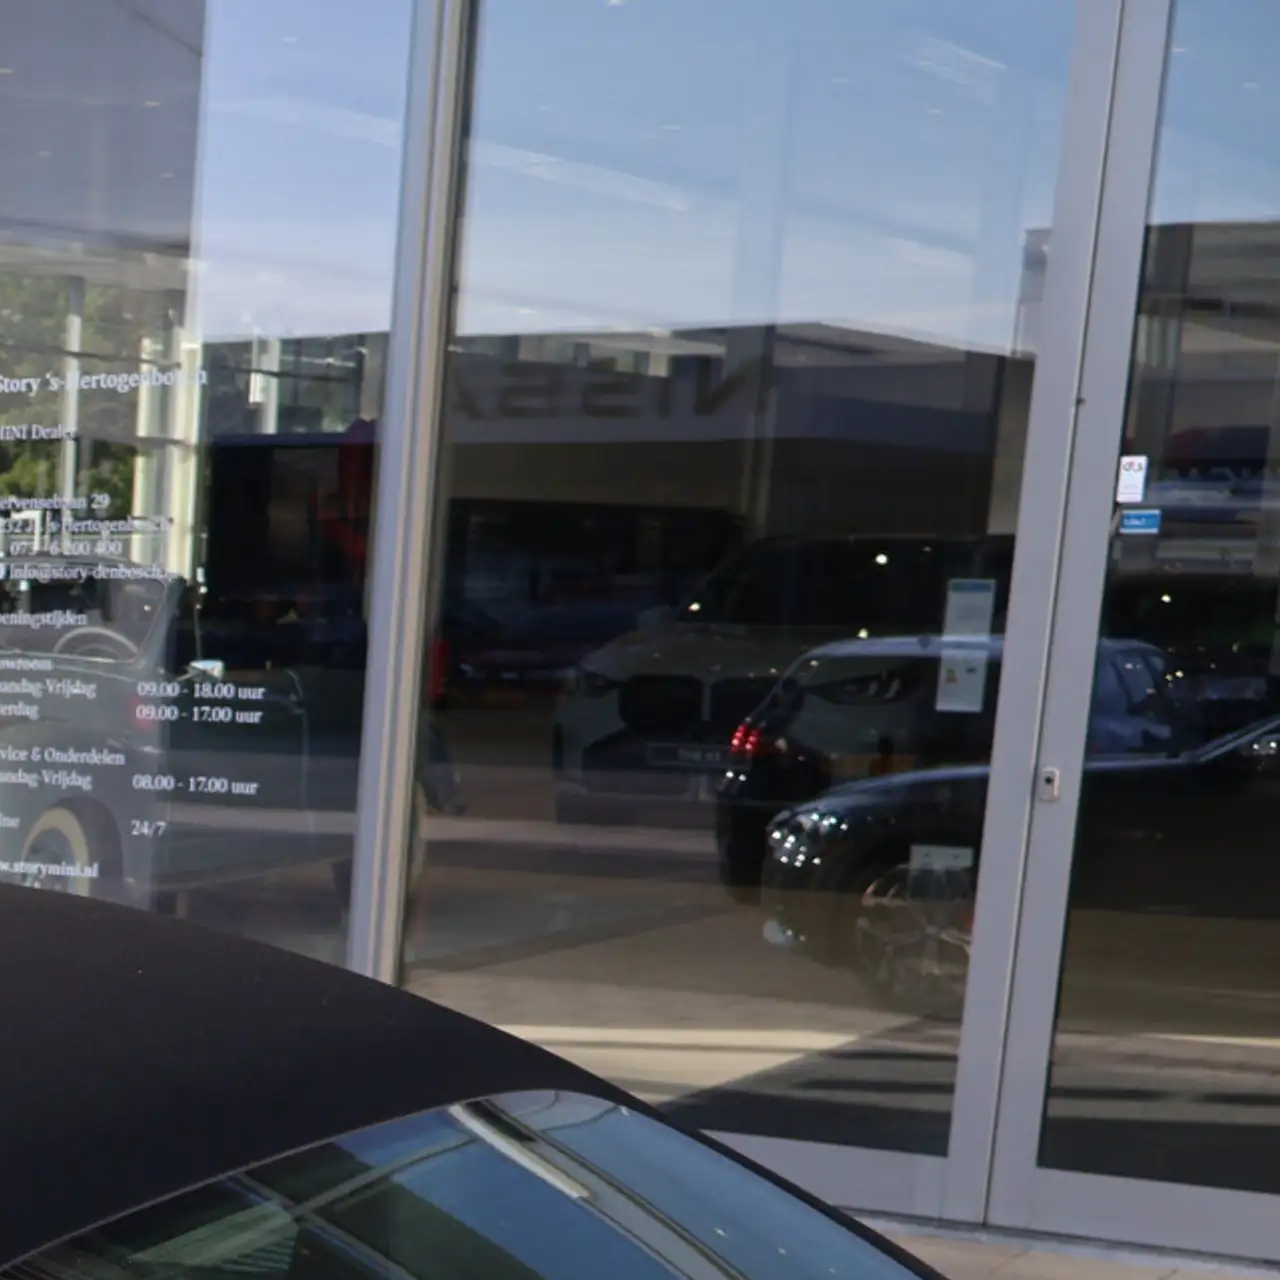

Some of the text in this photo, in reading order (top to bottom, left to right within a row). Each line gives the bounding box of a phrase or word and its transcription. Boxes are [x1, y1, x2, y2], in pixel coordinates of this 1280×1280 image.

[90, 493, 112, 509] 29
[137, 682, 180, 698] 09.00
[193, 682, 234, 699] 18.00
[238, 686, 265, 700] uur
[135, 705, 179, 721] 09.00
[192, 706, 233, 722] 17.00
[236, 709, 263, 724] uur
[31, 748, 41, 762] &
[44, 747, 126, 766] Onderdelen
[132, 774, 176, 791] 08.00
[187, 776, 228, 793] 17.00
[231, 780, 260, 796] uur
[131, 819, 167, 837] 24/7
